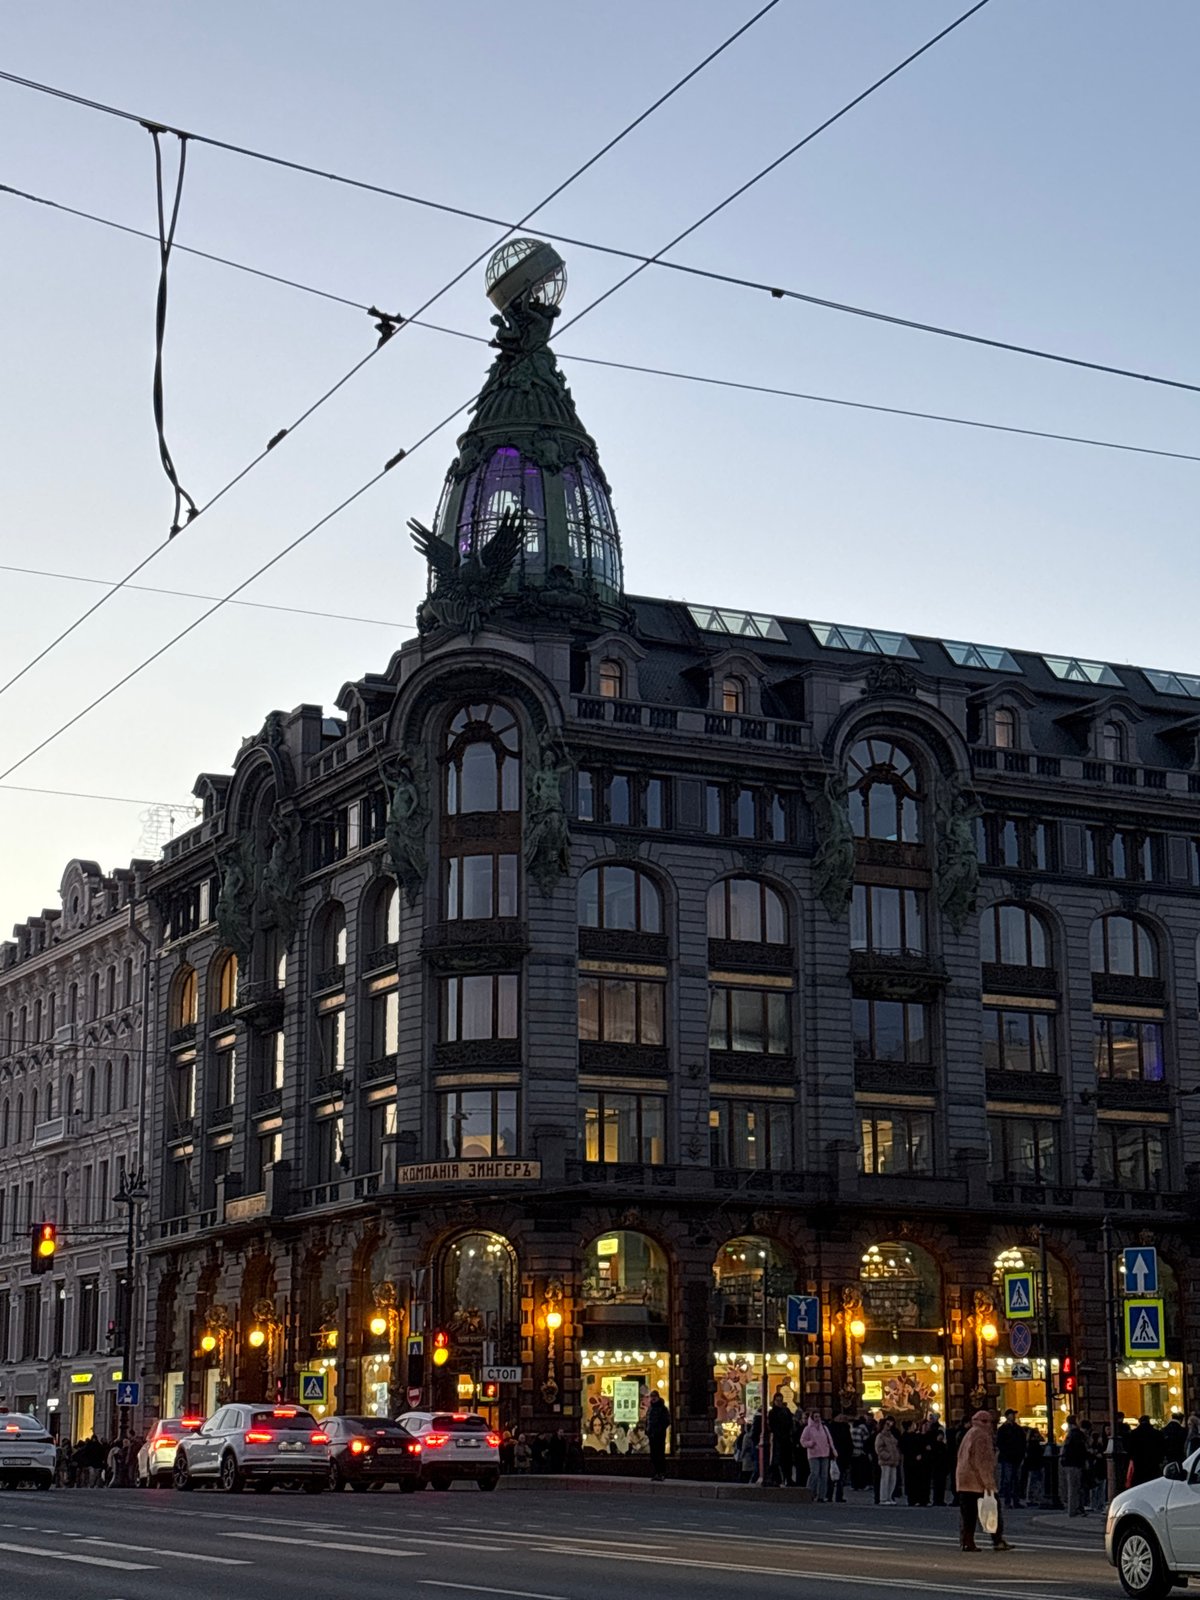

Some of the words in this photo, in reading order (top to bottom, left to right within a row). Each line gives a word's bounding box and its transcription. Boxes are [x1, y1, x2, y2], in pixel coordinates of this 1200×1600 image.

[402, 1164, 459, 1181] КОМПАНІЯ
[468, 1163, 531, 1177] ЗИНГЕРЪ
[487, 1369, 517, 1380] СТОП
